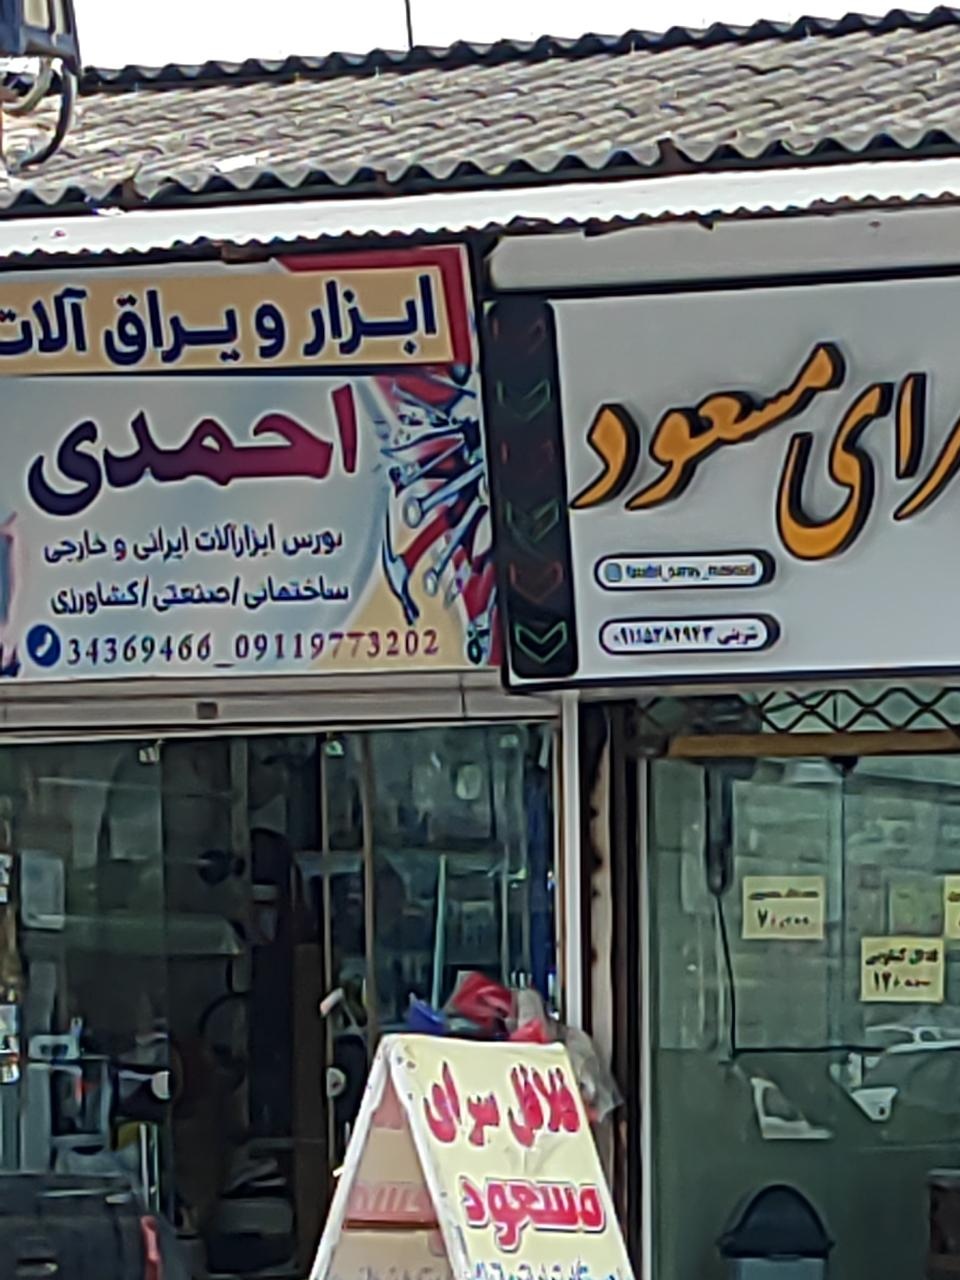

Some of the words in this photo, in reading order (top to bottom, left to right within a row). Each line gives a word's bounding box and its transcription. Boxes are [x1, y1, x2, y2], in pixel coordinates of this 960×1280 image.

[104, 290, 239, 364] یراق
[254, 303, 286, 358] و
[303, 274, 437, 355] ابزار
[27, 383, 359, 516] احمدی
[570, 341, 847, 512] مسعود
[44, 529, 107, 563] خارجی
[113, 538, 127, 562] و
[133, 525, 189, 561] ایرانی
[282, 529, 342, 555] بورس
[459, 1175, 606, 1252] مسعود
